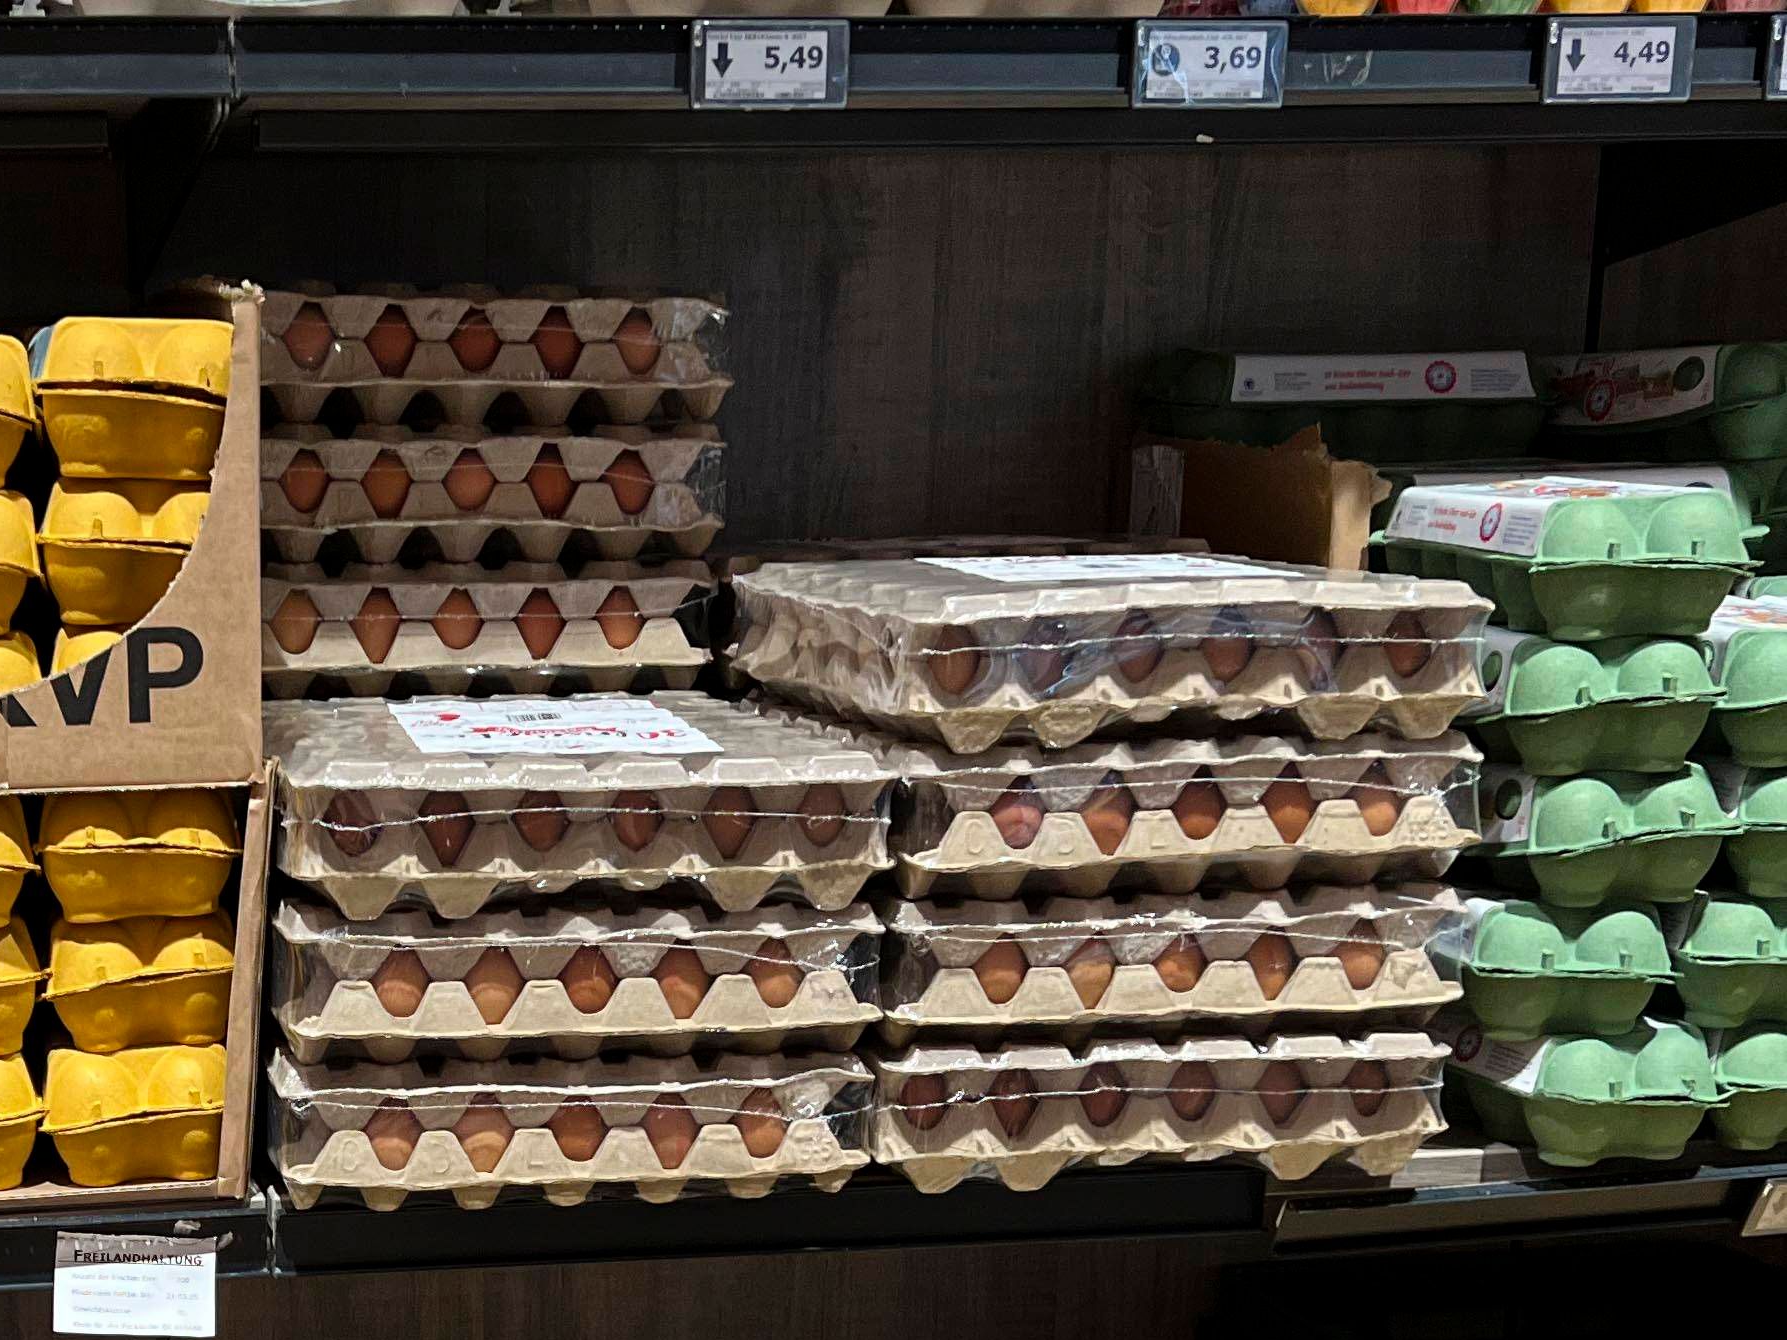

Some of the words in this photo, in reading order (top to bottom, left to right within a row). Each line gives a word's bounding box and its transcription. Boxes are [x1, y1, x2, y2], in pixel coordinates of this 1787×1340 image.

[764, 45, 823, 74] 5,49
[1204, 46, 1261, 74] 3,69
[1613, 40, 1670, 67] 4,49
[74, 1250, 204, 1267] FREILANDHALTUNG
